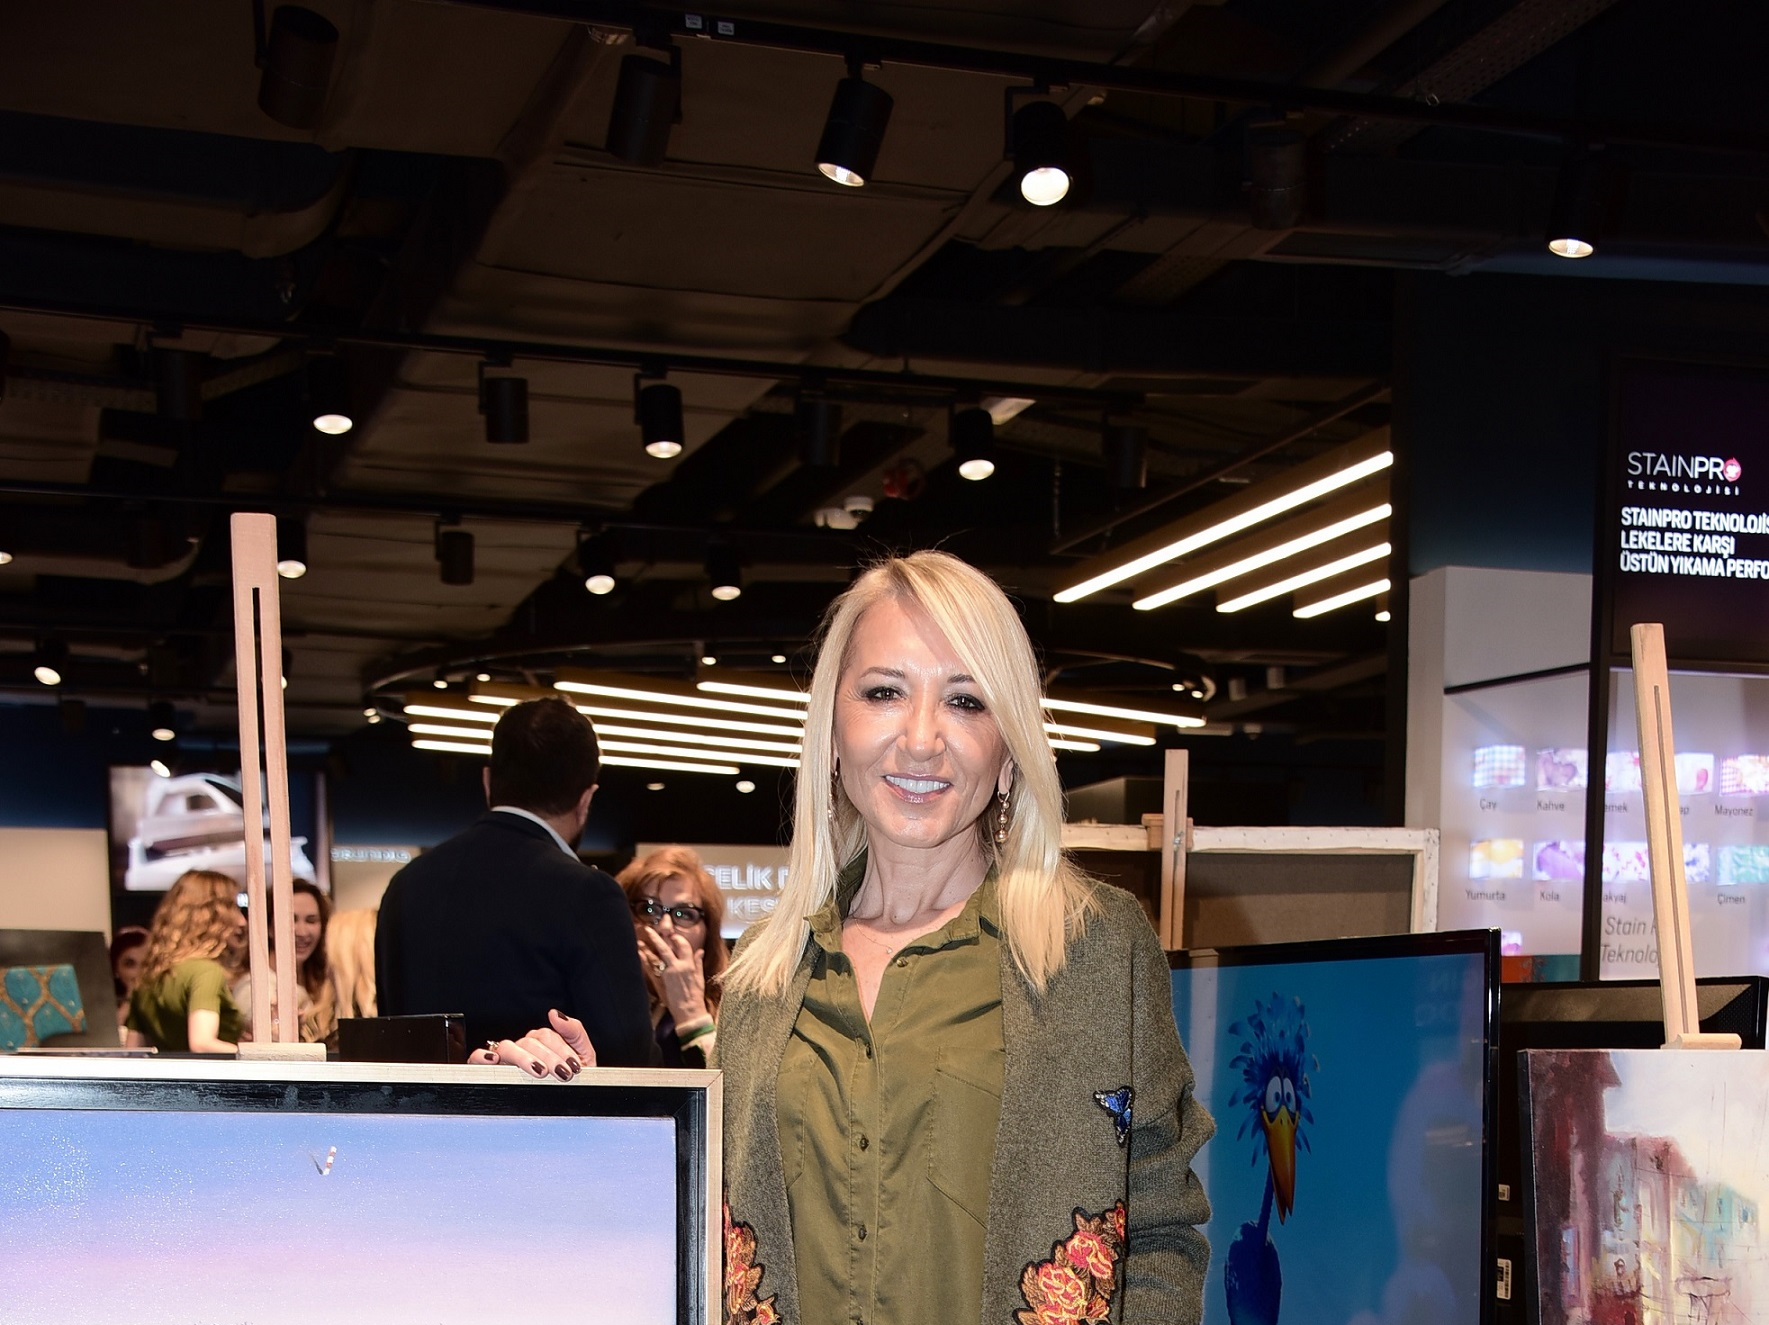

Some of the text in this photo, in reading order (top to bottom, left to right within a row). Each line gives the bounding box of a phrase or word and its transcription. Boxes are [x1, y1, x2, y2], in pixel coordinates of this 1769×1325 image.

[1621, 506, 1692, 530] STAINPRO
[1621, 529, 1736, 559] LEKELERE KARŞI
[1620, 550, 1669, 574] ÜSTÜN
[1670, 556, 1726, 577] YIKAMA
[1479, 797, 1497, 812] Çay
[1537, 800, 1566, 812] Kahve
[1604, 802, 1628, 813] emek
[1714, 805, 1754, 819] Mayonez
[1465, 888, 1506, 902] Yumurta
[1540, 890, 1560, 902] Kola
[1602, 890, 1627, 904] akyaj
[1717, 893, 1746, 906] Çimen
[727, 895, 780, 917] KES
[1604, 916, 1646, 936] Stain
[1601, 943, 1659, 965] Teknolo
